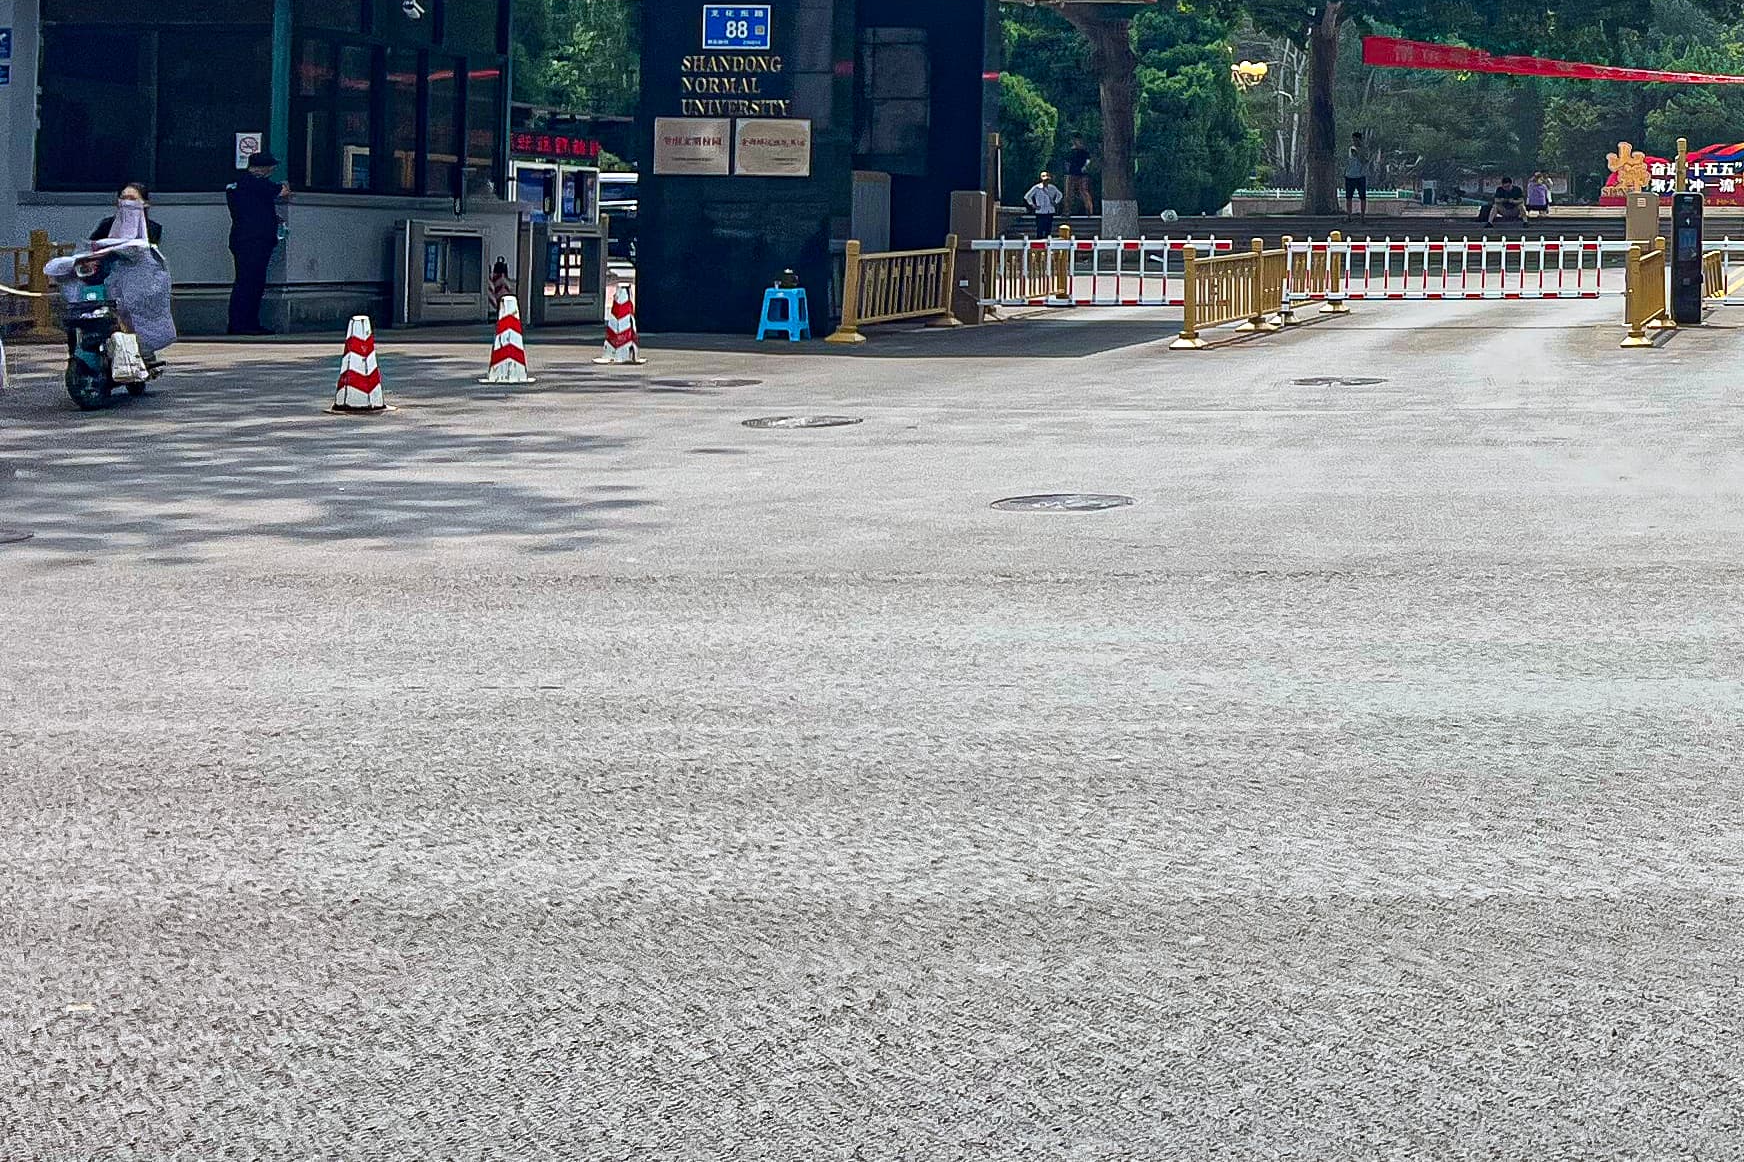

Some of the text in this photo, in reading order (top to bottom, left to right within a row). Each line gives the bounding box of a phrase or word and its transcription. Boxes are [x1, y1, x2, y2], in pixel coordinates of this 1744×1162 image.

[725, 20, 748, 39] 88
[681, 55, 784, 73] SHANDONG
[681, 77, 761, 94] NORMAL
[681, 98, 791, 116] UNIVERSITY
